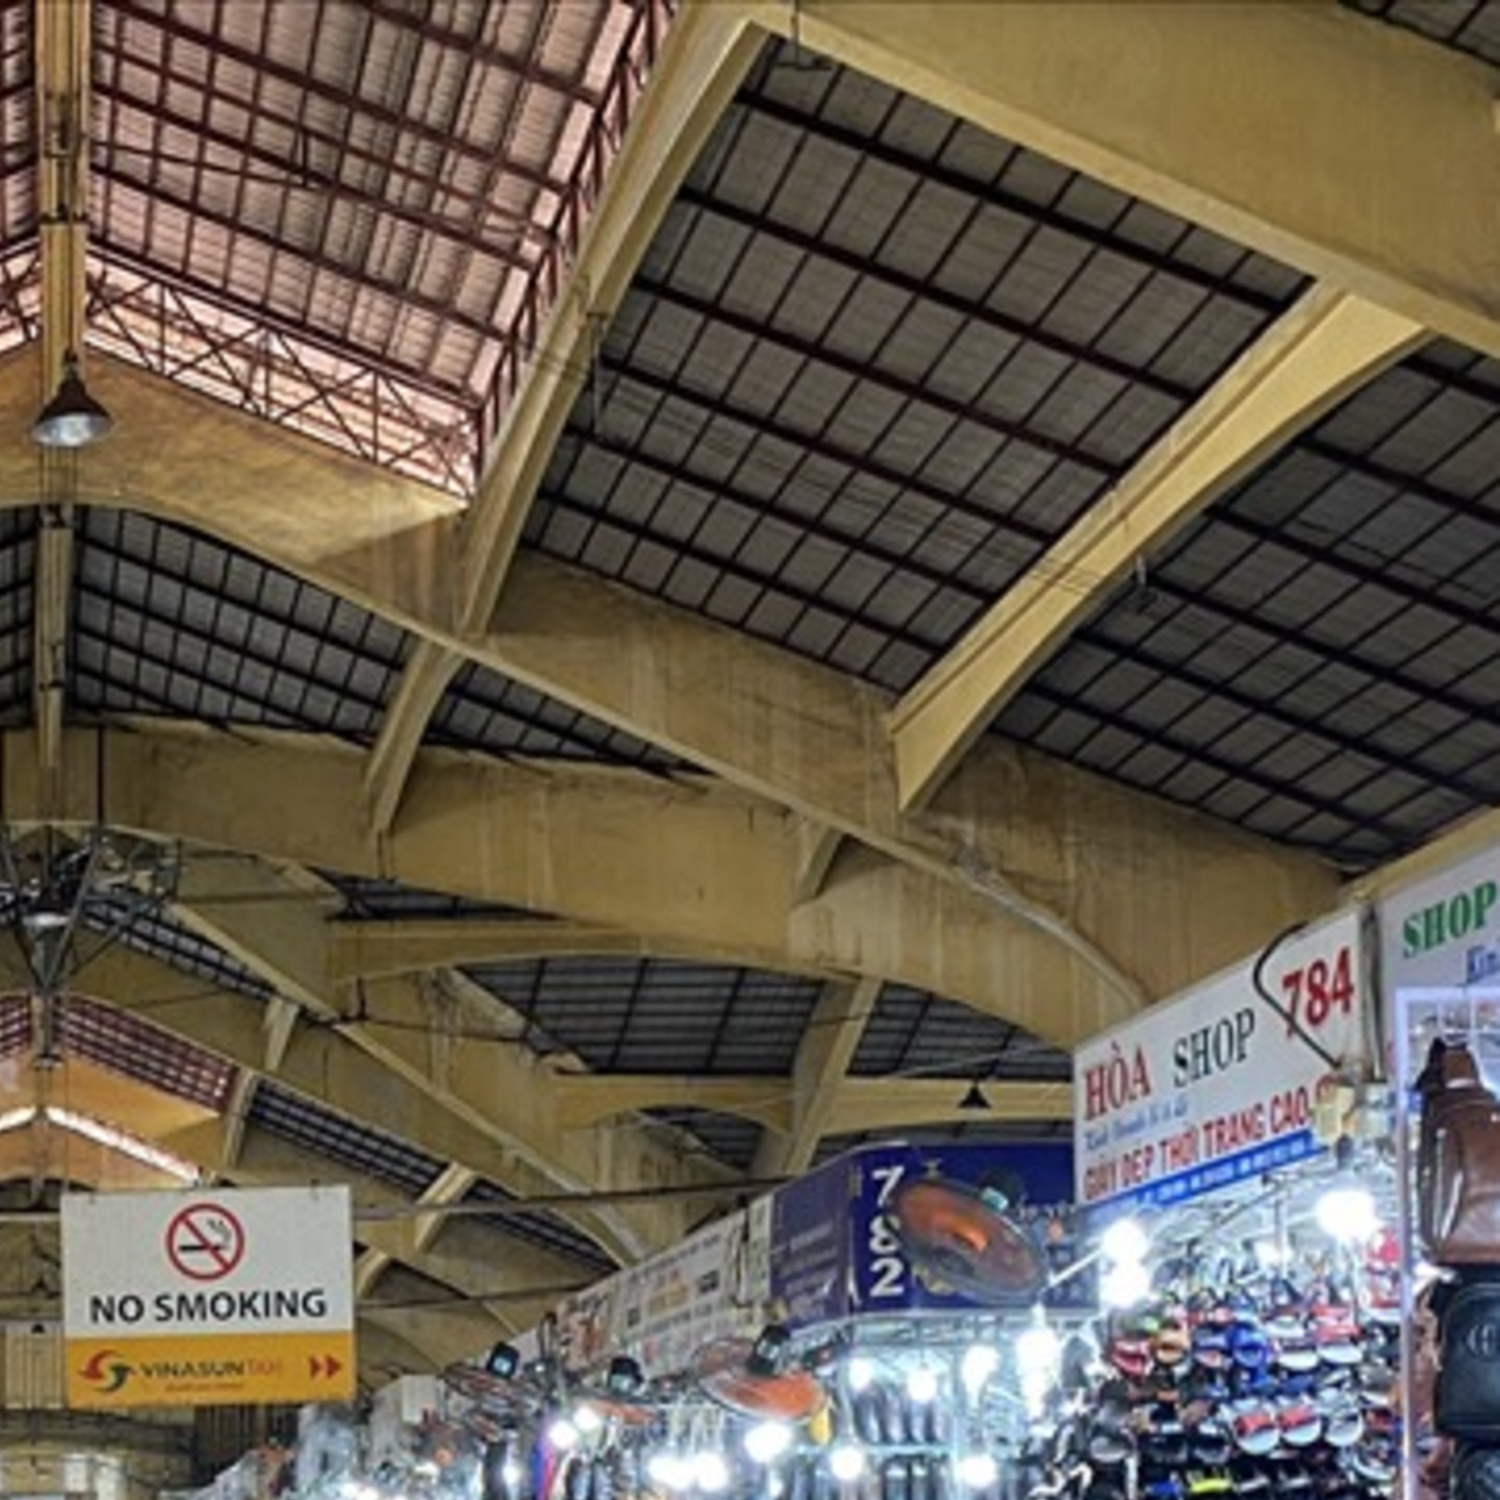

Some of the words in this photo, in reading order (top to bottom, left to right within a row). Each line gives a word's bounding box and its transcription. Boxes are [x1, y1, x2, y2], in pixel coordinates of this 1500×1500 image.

[1402, 881, 1497, 959] SHOP
[1084, 1042, 1151, 1121] HÒA
[1173, 1007, 1255, 1088] SHOP
[1282, 947, 1355, 1040] 784
[90, 1295, 144, 1324] NO
[156, 1289, 327, 1322] SMOKING
